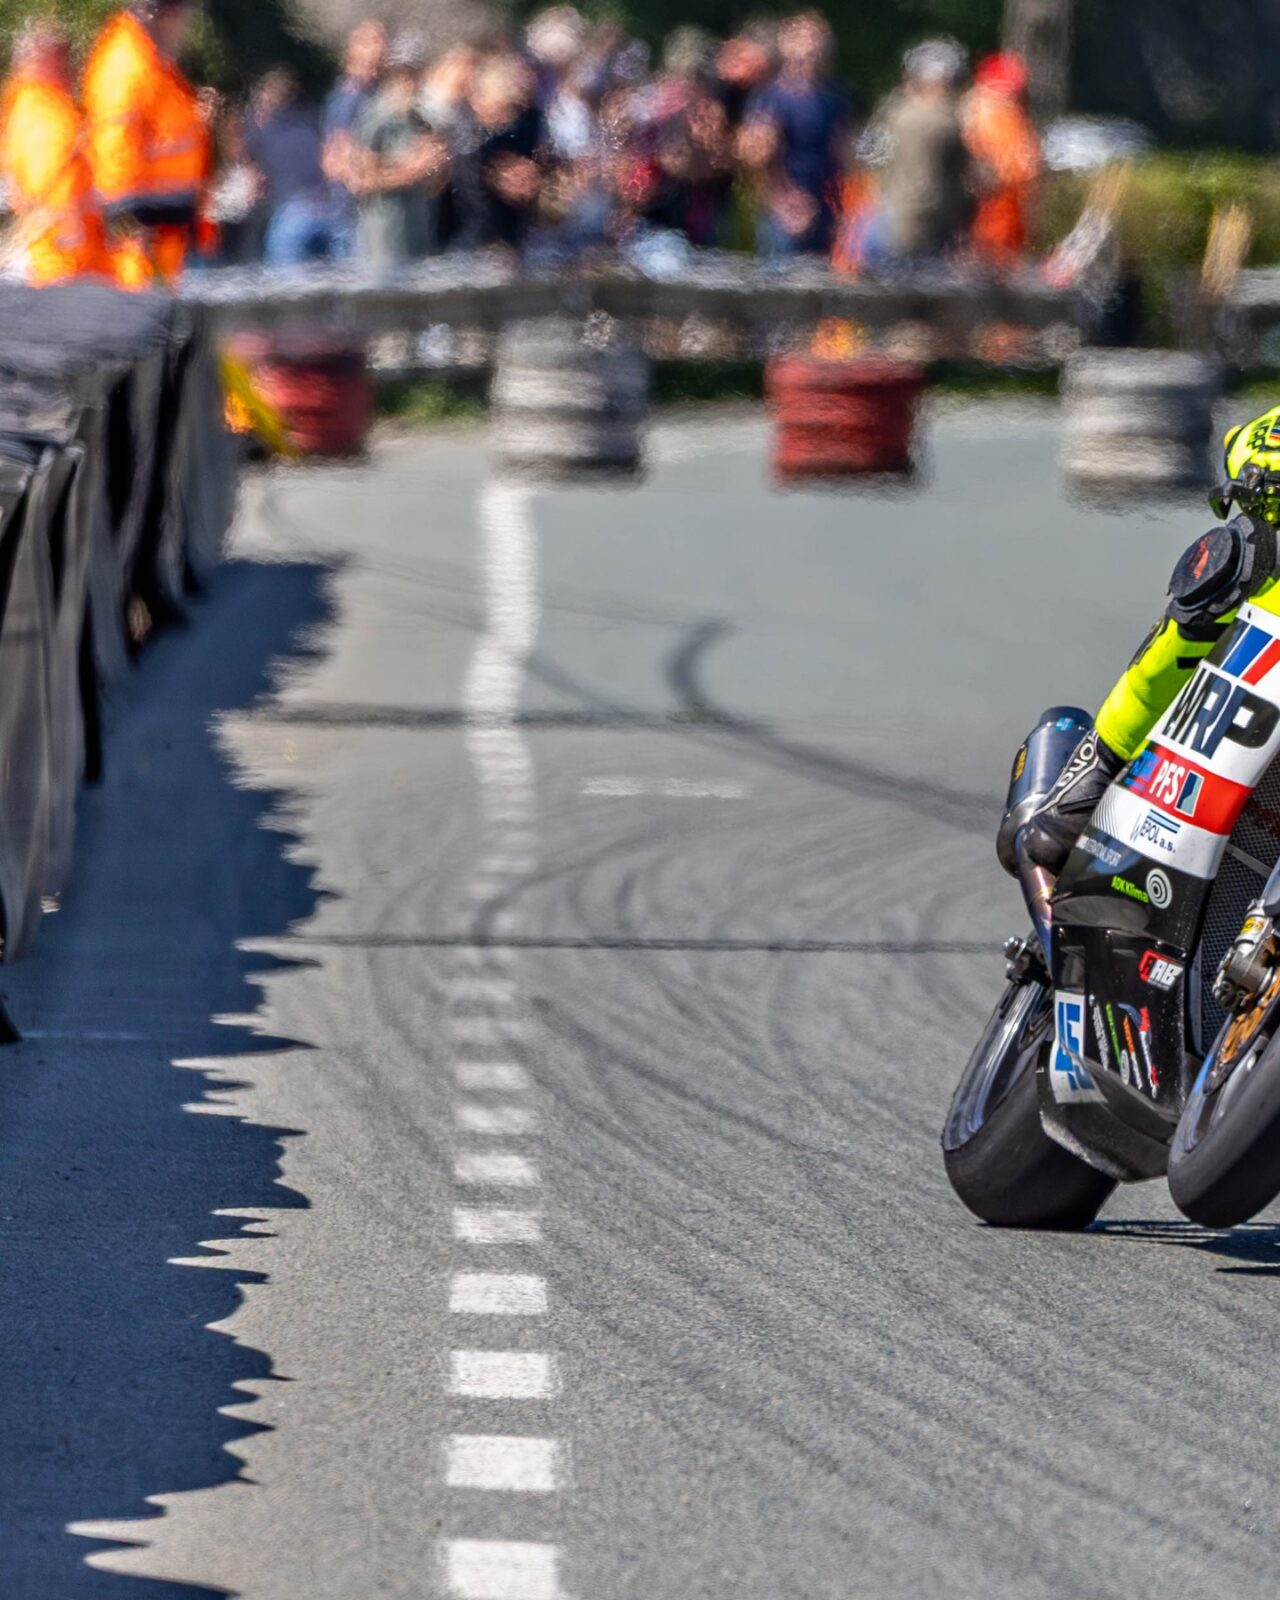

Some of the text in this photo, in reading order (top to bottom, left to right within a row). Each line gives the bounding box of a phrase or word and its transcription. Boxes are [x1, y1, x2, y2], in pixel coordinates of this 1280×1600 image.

[1161, 667, 1280, 760] WRP
[1148, 760, 1185, 804] PFS
[1129, 811, 1176, 853] WEPOL a.s.
